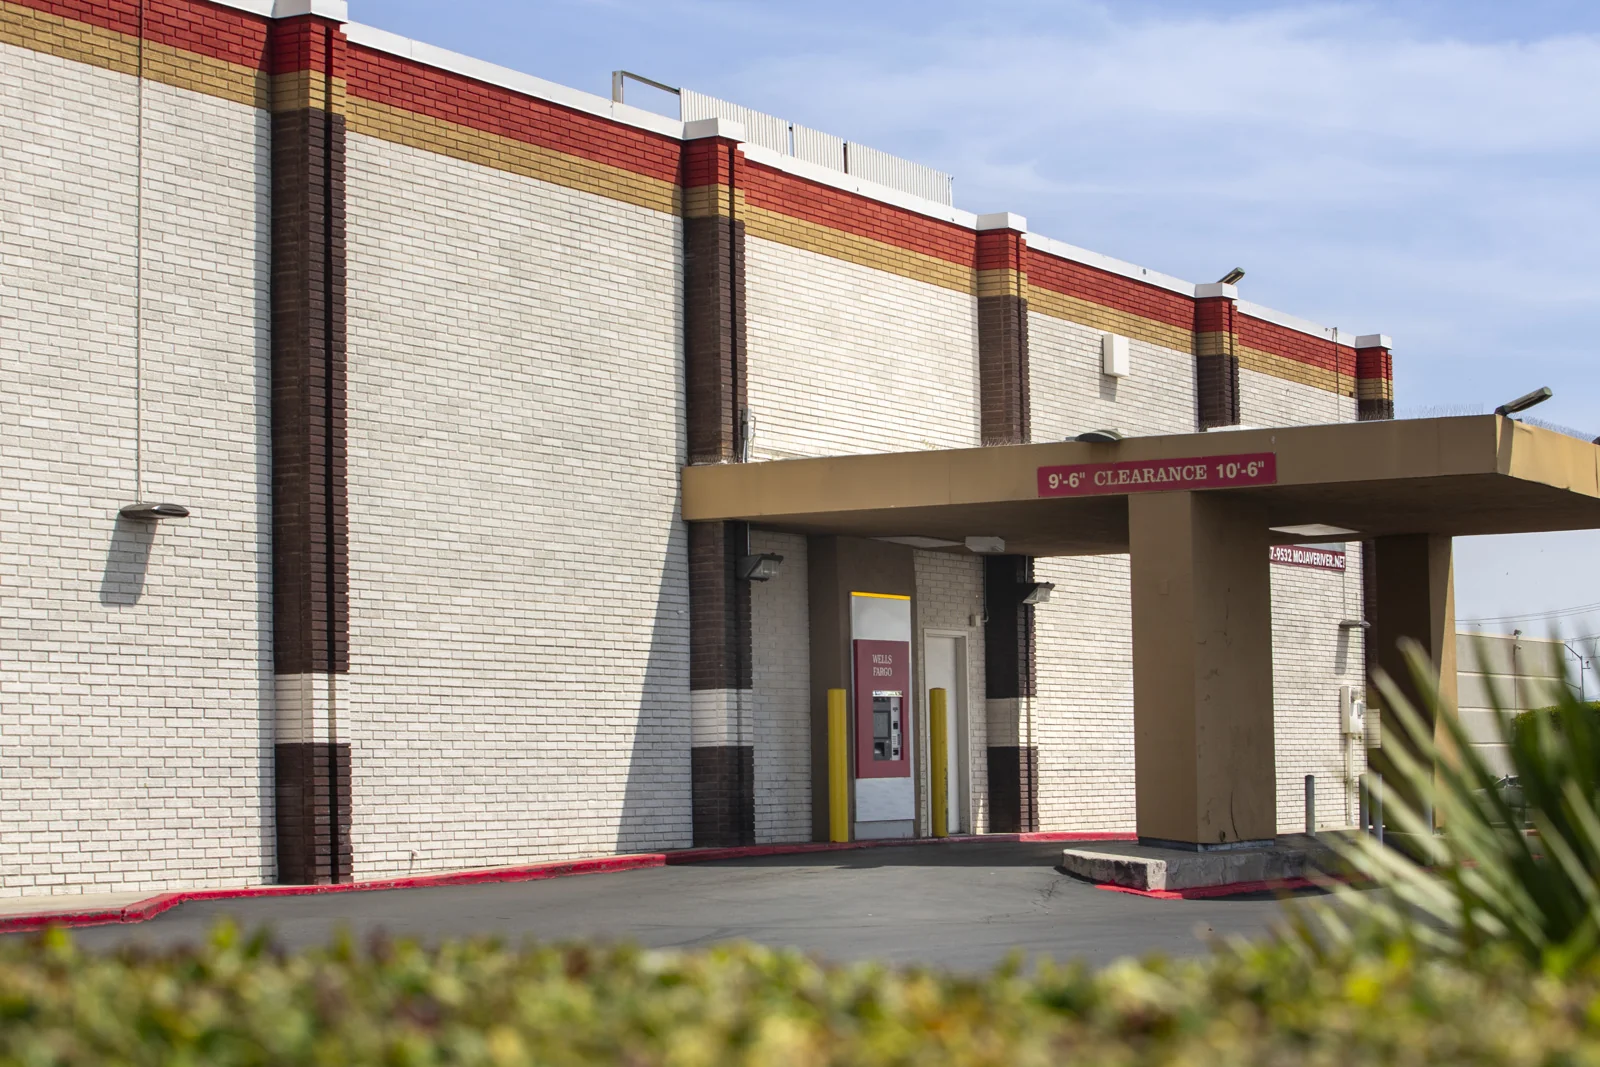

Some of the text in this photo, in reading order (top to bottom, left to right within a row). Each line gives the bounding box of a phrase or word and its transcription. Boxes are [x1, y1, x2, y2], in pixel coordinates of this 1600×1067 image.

[1048, 461, 1265, 489] 9'-6" CLEARANCE 10'-6"
[1293, 550, 1345, 568] MOJAVERIVER.NET
[872, 654, 893, 664] WELLS
[873, 667, 893, 677] FARGO
